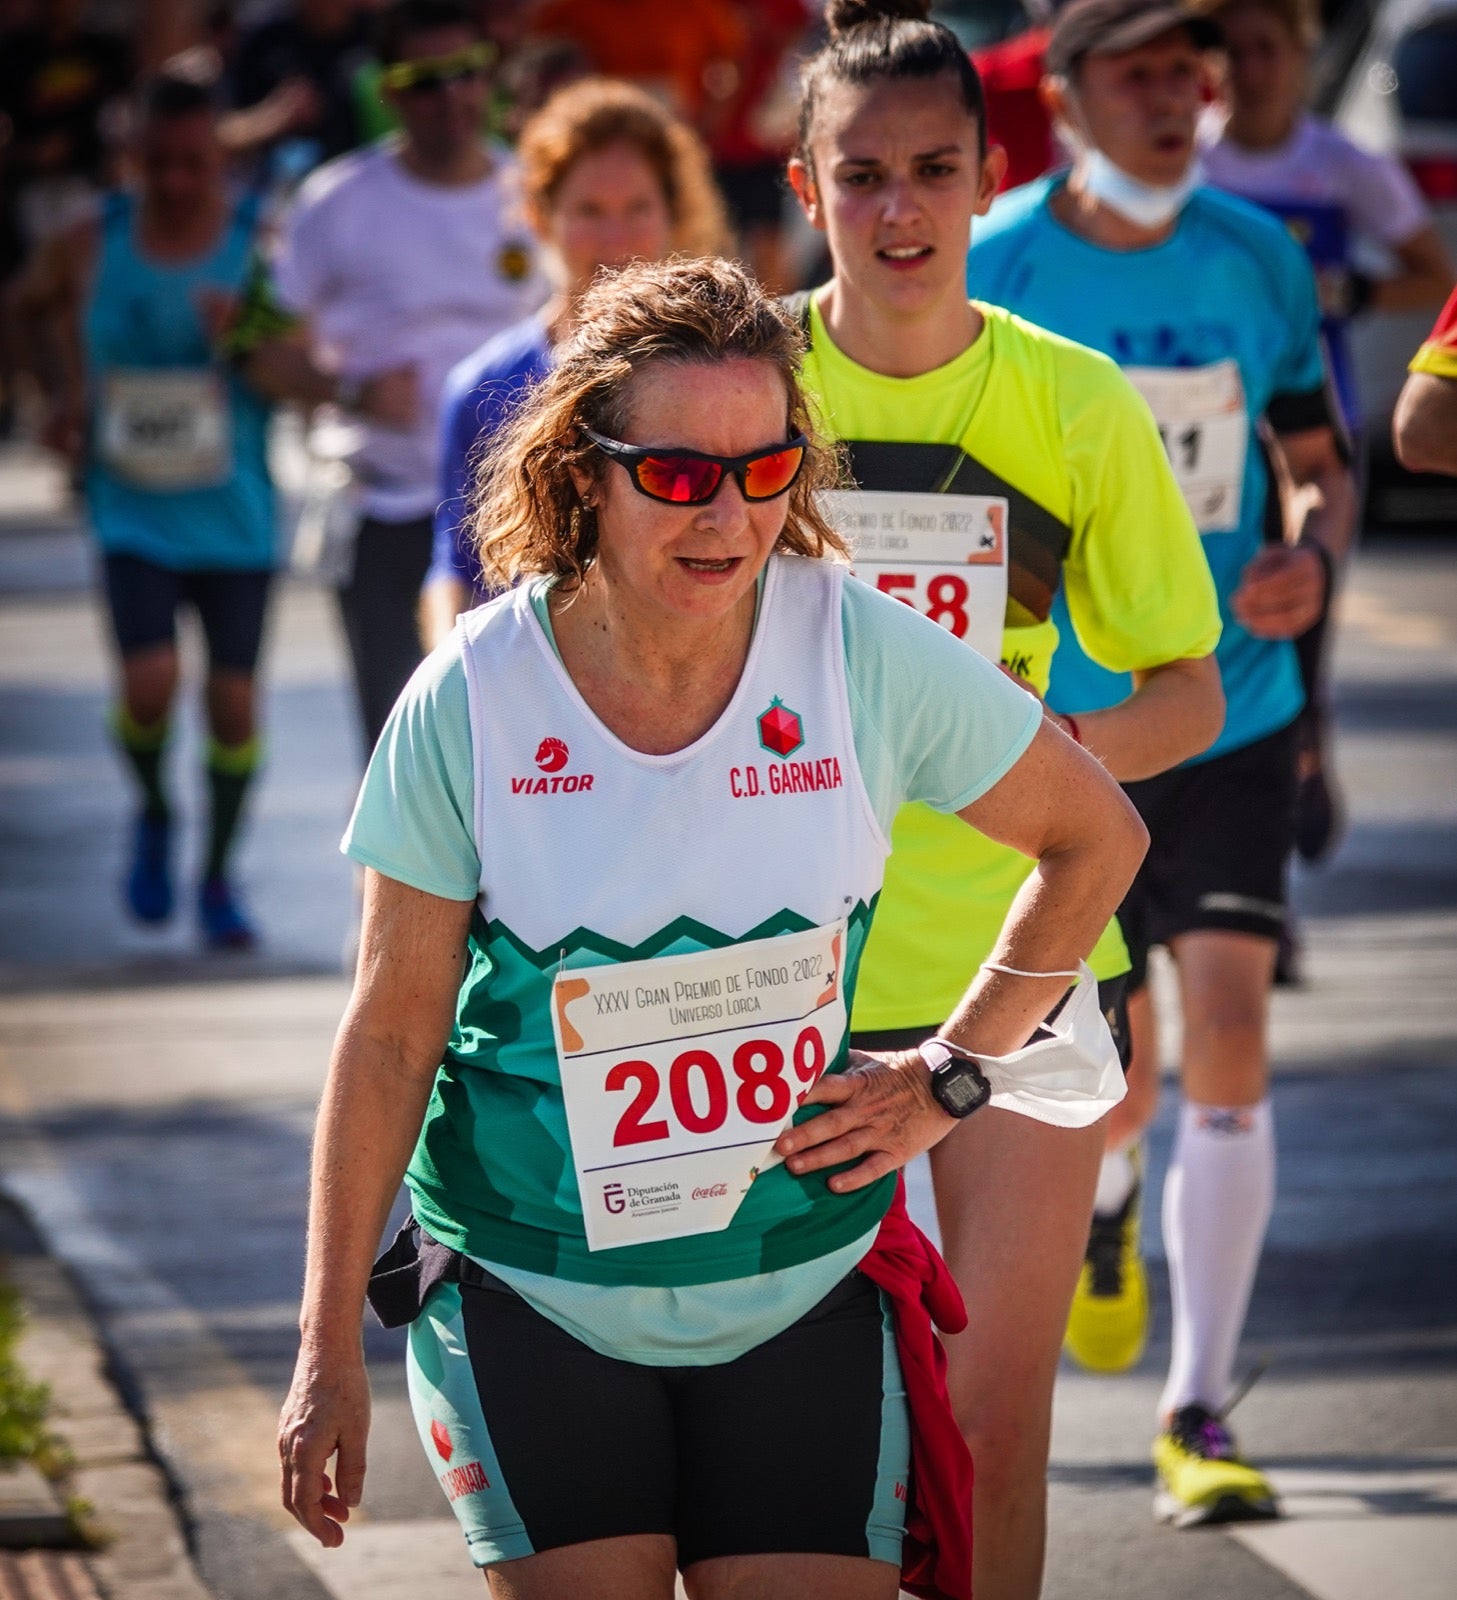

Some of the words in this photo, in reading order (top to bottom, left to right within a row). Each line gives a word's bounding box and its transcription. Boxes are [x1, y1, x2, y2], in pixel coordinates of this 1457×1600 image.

[511, 774, 594, 795] VIATOR
[730, 766, 765, 798] C.D.
[768, 757, 843, 795] GARNATA
[593, 990, 630, 1016] XXXV
[635, 986, 671, 1009] GRAN
[674, 980, 722, 1003] PREMIO
[726, 974, 742, 994] DE
[746, 967, 789, 990] FONDO
[792, 954, 823, 982] 2022
[669, 1005, 723, 1026] UNIVERSO
[726, 996, 762, 1016] LORCA
[605, 1026, 826, 1148] 2089
[627, 1182, 679, 1198] Diputación
[629, 1198, 641, 1208] de
[641, 1191, 681, 1206] Granada
